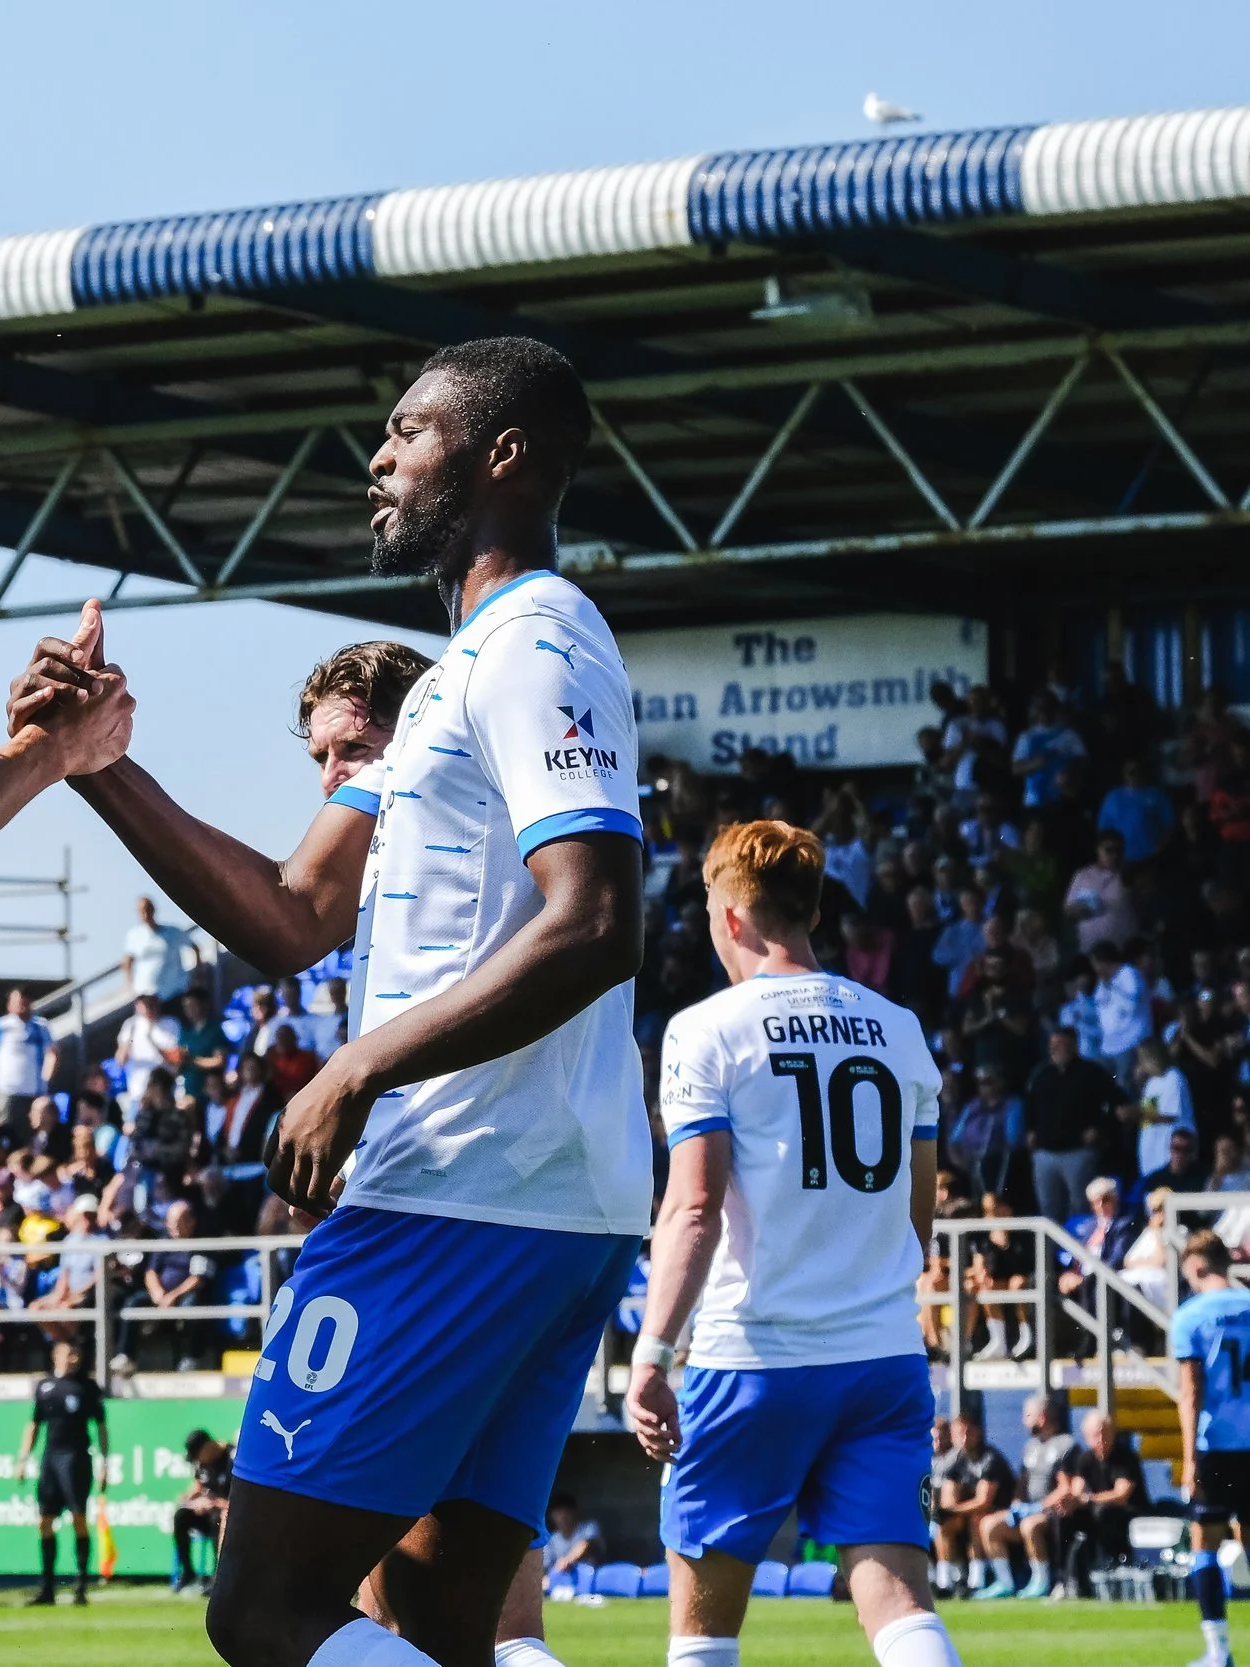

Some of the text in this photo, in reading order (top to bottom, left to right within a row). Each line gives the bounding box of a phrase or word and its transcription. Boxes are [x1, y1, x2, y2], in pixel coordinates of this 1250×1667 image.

[733, 631, 817, 667] The
[544, 747, 618, 771] KEYIN
[559, 768, 614, 781] COLLEGE
[763, 1015, 888, 1047] GARNER
[768, 1053, 902, 1194] 10
[254, 1286, 359, 1393] 20
